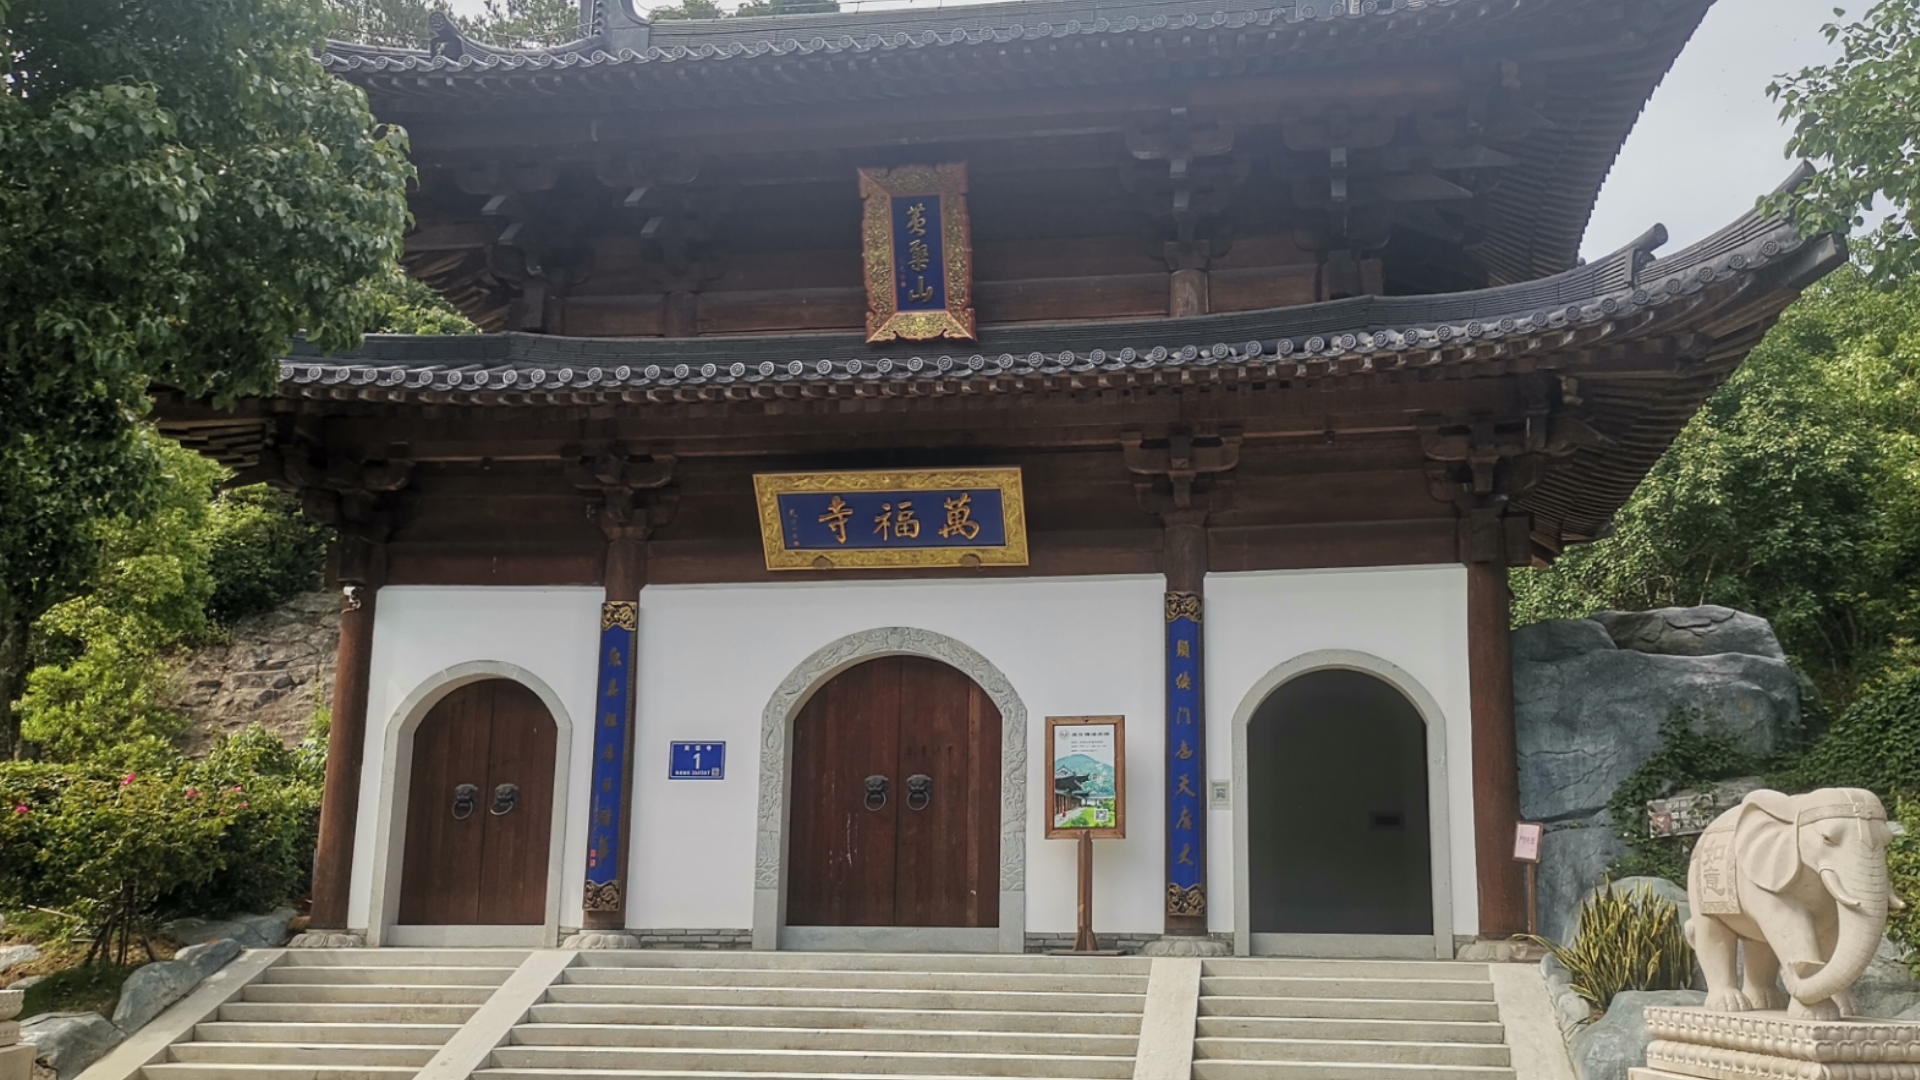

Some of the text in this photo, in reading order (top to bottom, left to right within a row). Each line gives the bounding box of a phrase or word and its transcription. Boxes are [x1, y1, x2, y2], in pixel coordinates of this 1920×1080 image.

[818, 492, 981, 545] 萬福寺
[692, 752, 702, 770] 1
[1702, 838, 1726, 897] 如意
